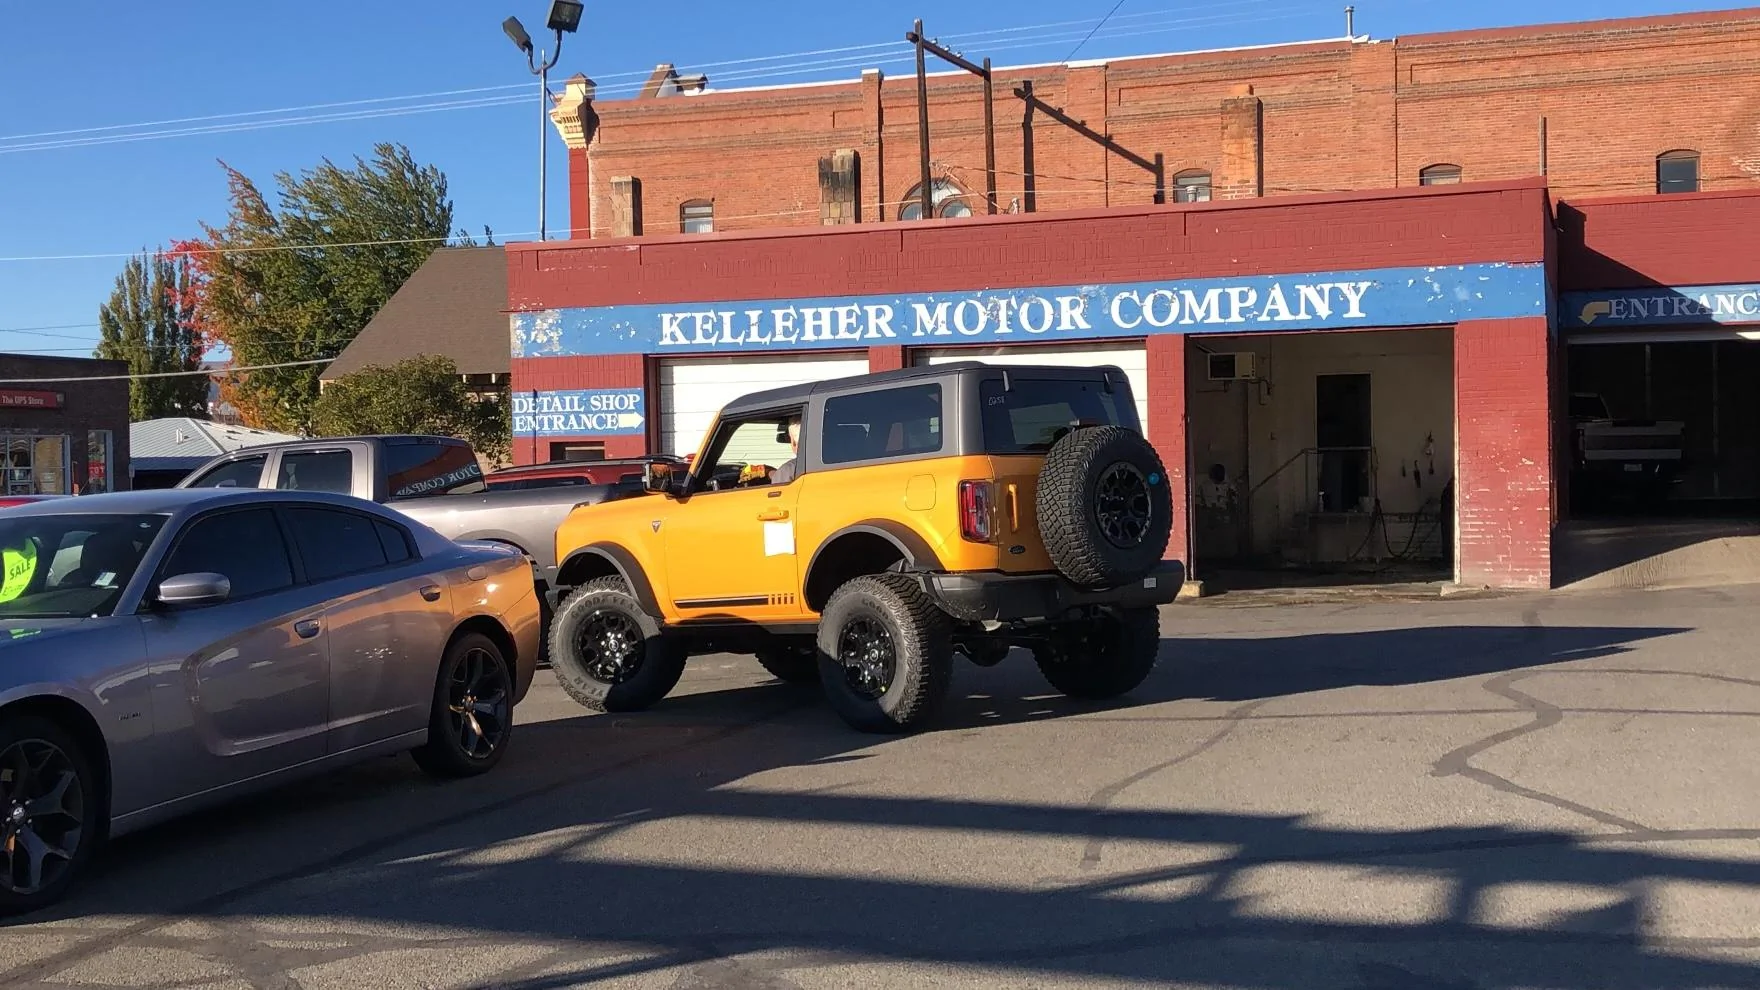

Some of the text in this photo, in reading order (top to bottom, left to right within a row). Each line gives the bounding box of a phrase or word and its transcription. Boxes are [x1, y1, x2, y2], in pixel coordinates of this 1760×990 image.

[658, 281, 1372, 347] KELLEHER MOTOR COMPANY
[1608, 292, 1760, 319] ENTRANC
[2, 395, 44, 405] The UPS Store
[513, 394, 640, 413] DETAIL SHOP
[514, 412, 619, 432] ENTRANCE
[9, 560, 31, 580] SALE
